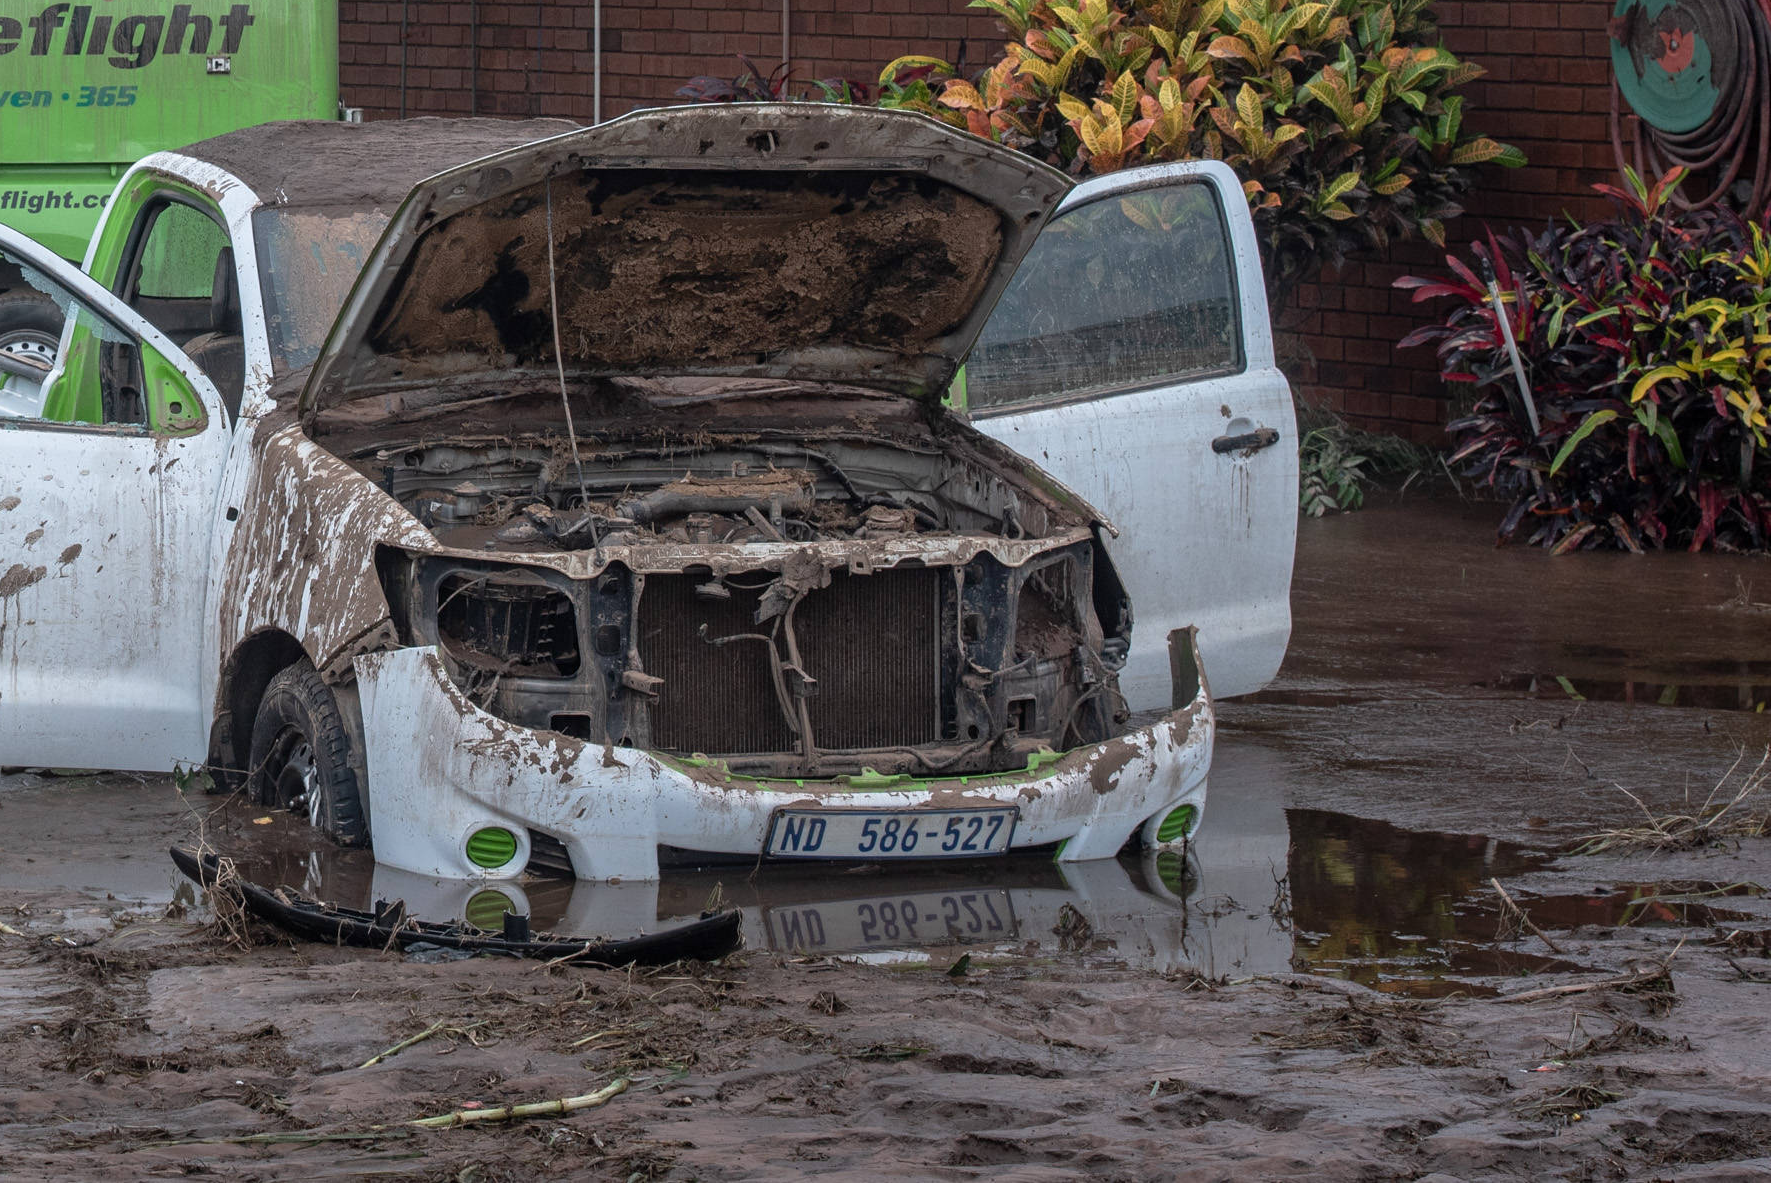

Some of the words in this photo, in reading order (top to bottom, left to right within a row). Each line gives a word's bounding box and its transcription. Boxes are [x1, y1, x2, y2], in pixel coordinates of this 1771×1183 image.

[79, 85, 137, 108] 365
[780, 817, 827, 852] ND
[858, 815, 1004, 852] 586-527
